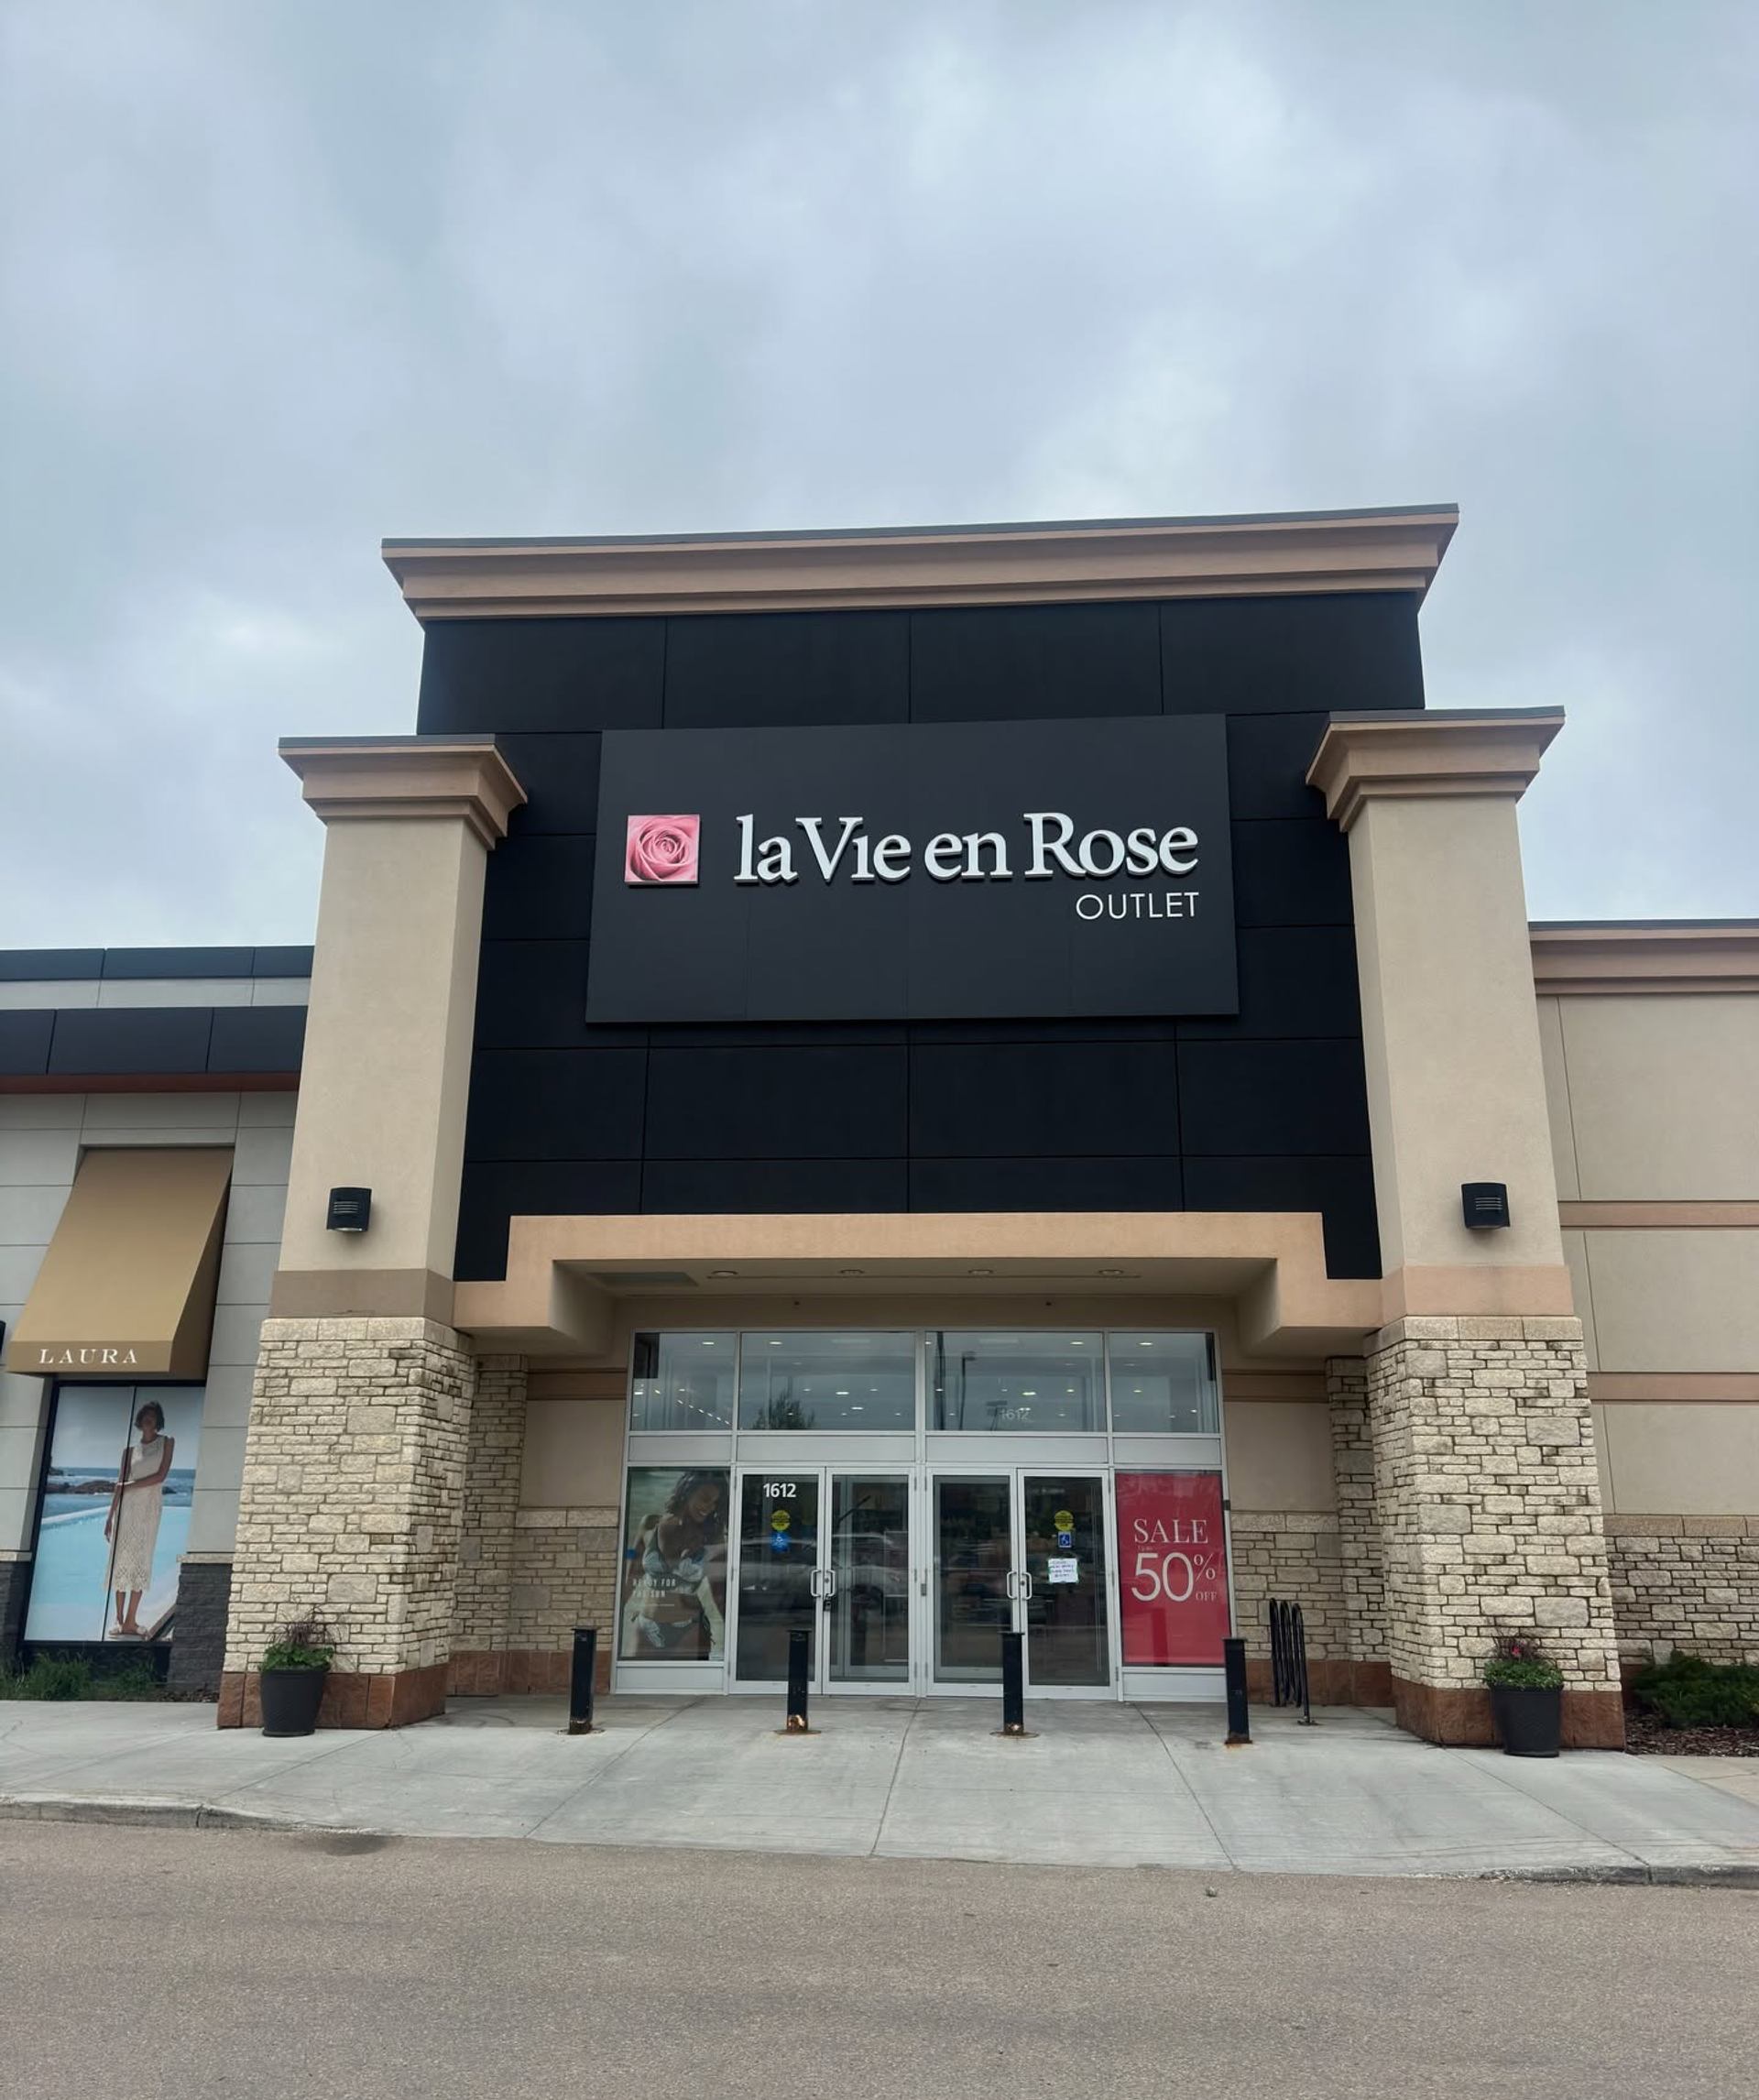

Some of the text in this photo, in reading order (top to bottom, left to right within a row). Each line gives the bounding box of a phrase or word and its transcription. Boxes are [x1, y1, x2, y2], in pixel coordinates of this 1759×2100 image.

[734, 812, 1199, 883] la Vie en Rose
[1076, 891, 1200, 920] OUTLET
[38, 1348, 137, 1364] LAURA
[762, 1482, 797, 1498] 1612
[1133, 1518, 1208, 1544] SALE
[1195, 1591, 1218, 1602] OFF
